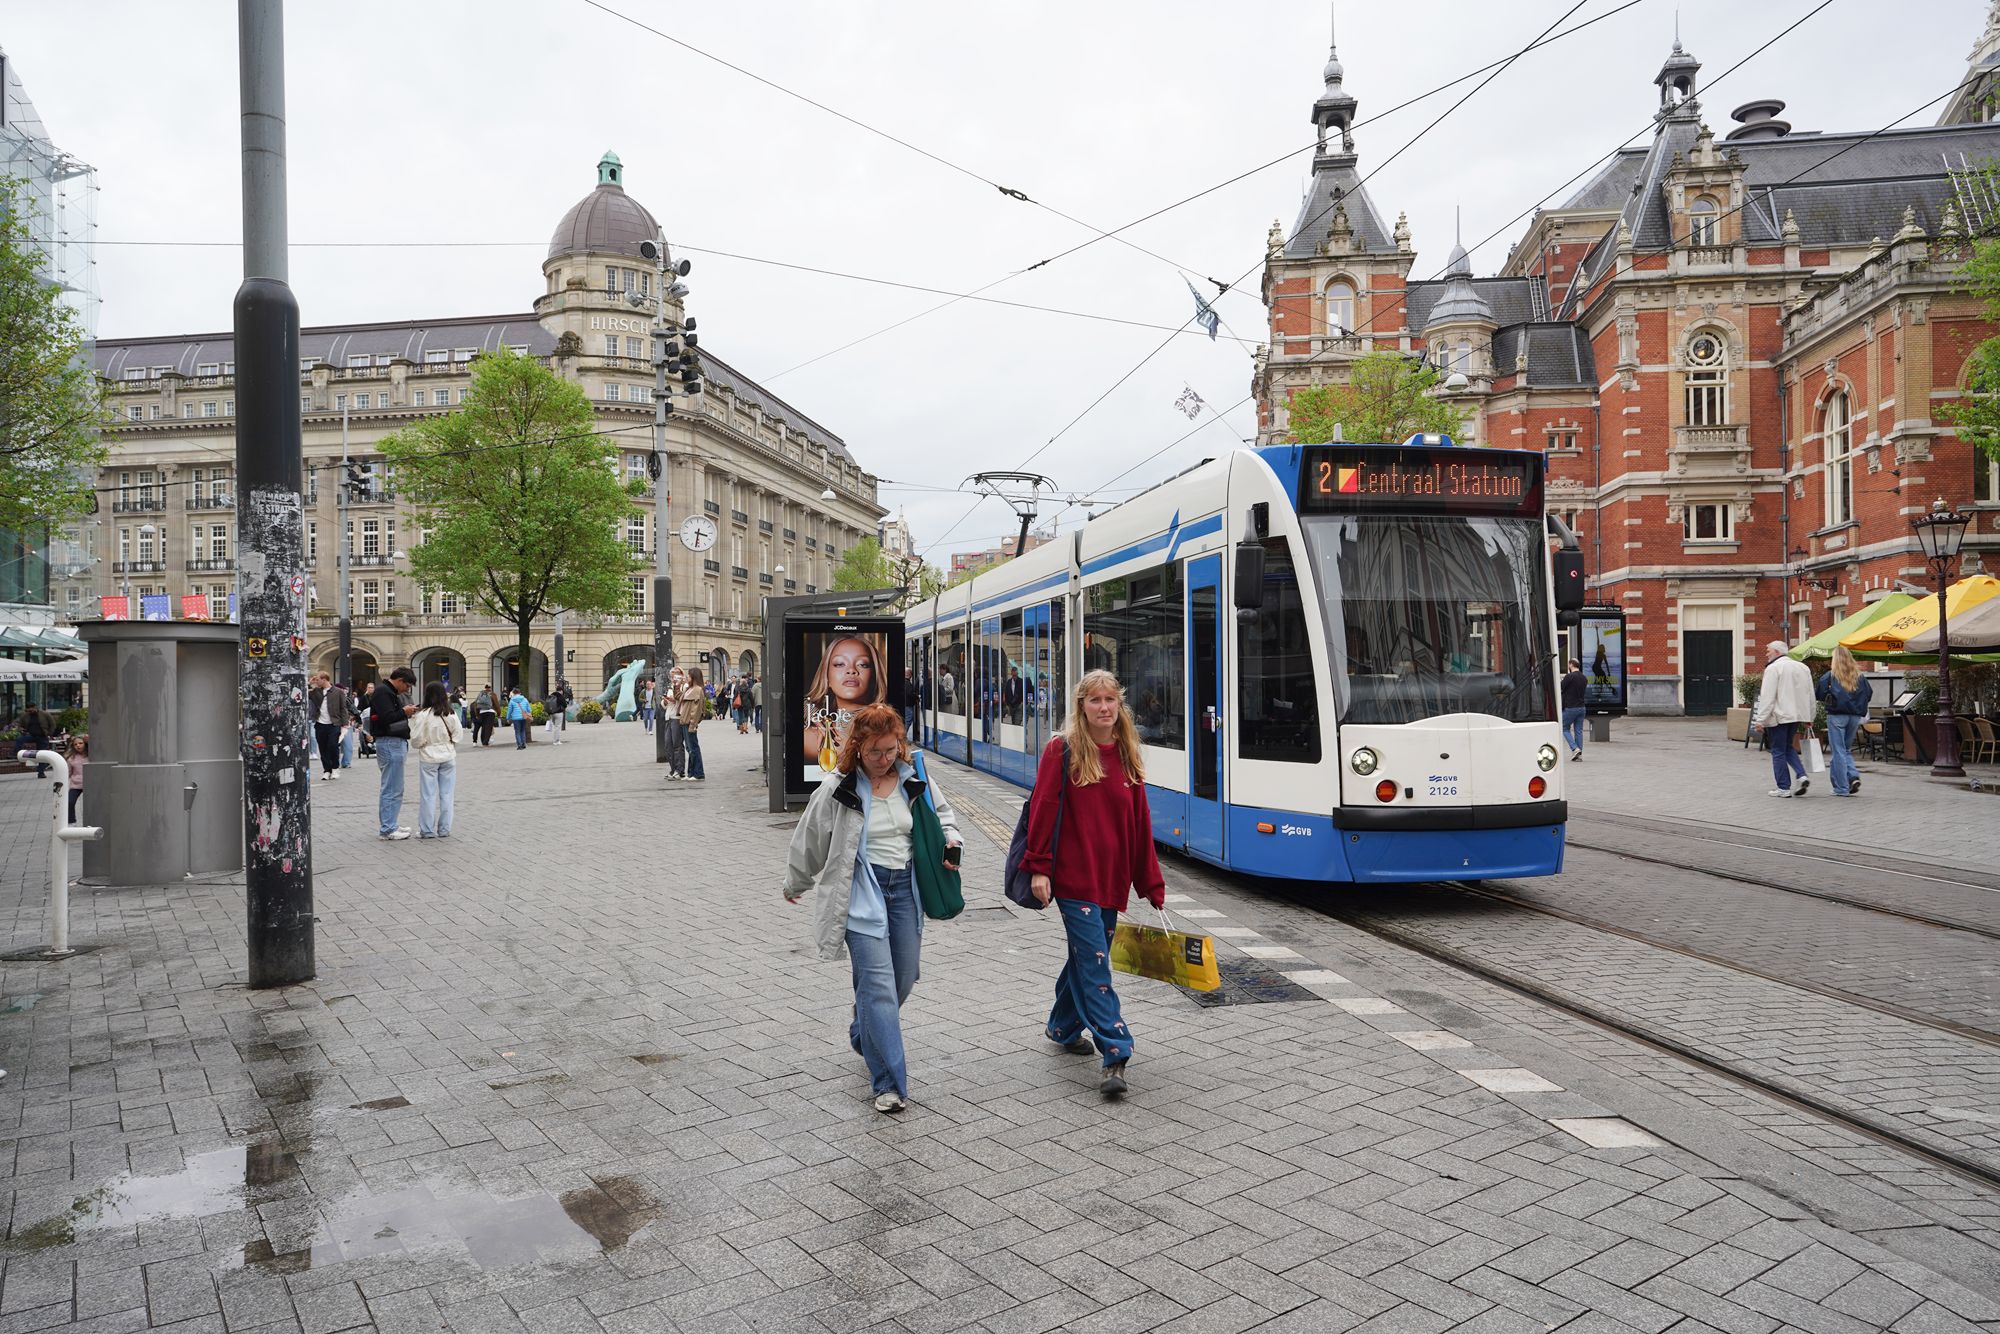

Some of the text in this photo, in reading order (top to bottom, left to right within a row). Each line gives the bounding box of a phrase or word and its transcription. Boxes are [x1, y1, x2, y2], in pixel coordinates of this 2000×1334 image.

[591, 316, 649, 335] HIRSCH
[1319, 461, 1521, 496] 2 Centraal Station
[1430, 787, 1457, 796] 2126
[1296, 827, 1312, 836] GVB
